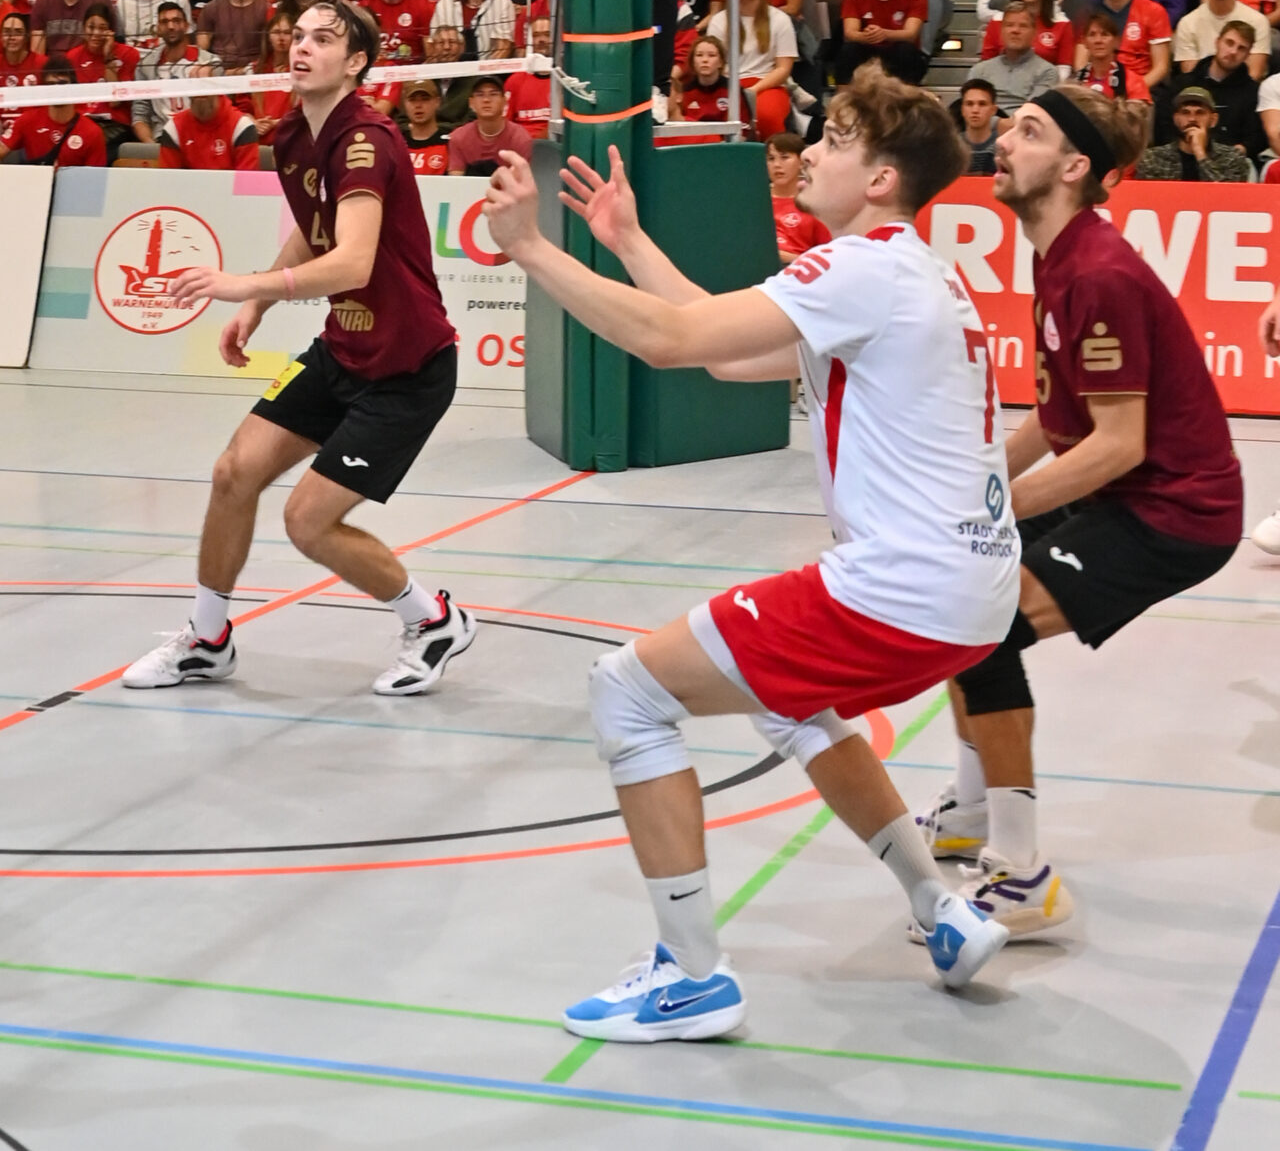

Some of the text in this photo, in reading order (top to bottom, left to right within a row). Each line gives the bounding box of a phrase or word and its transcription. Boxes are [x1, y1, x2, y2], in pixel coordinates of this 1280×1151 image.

[311, 211, 331, 251] 4
[461, 274, 504, 284] LIEBEN
[962, 327, 995, 444] 7
